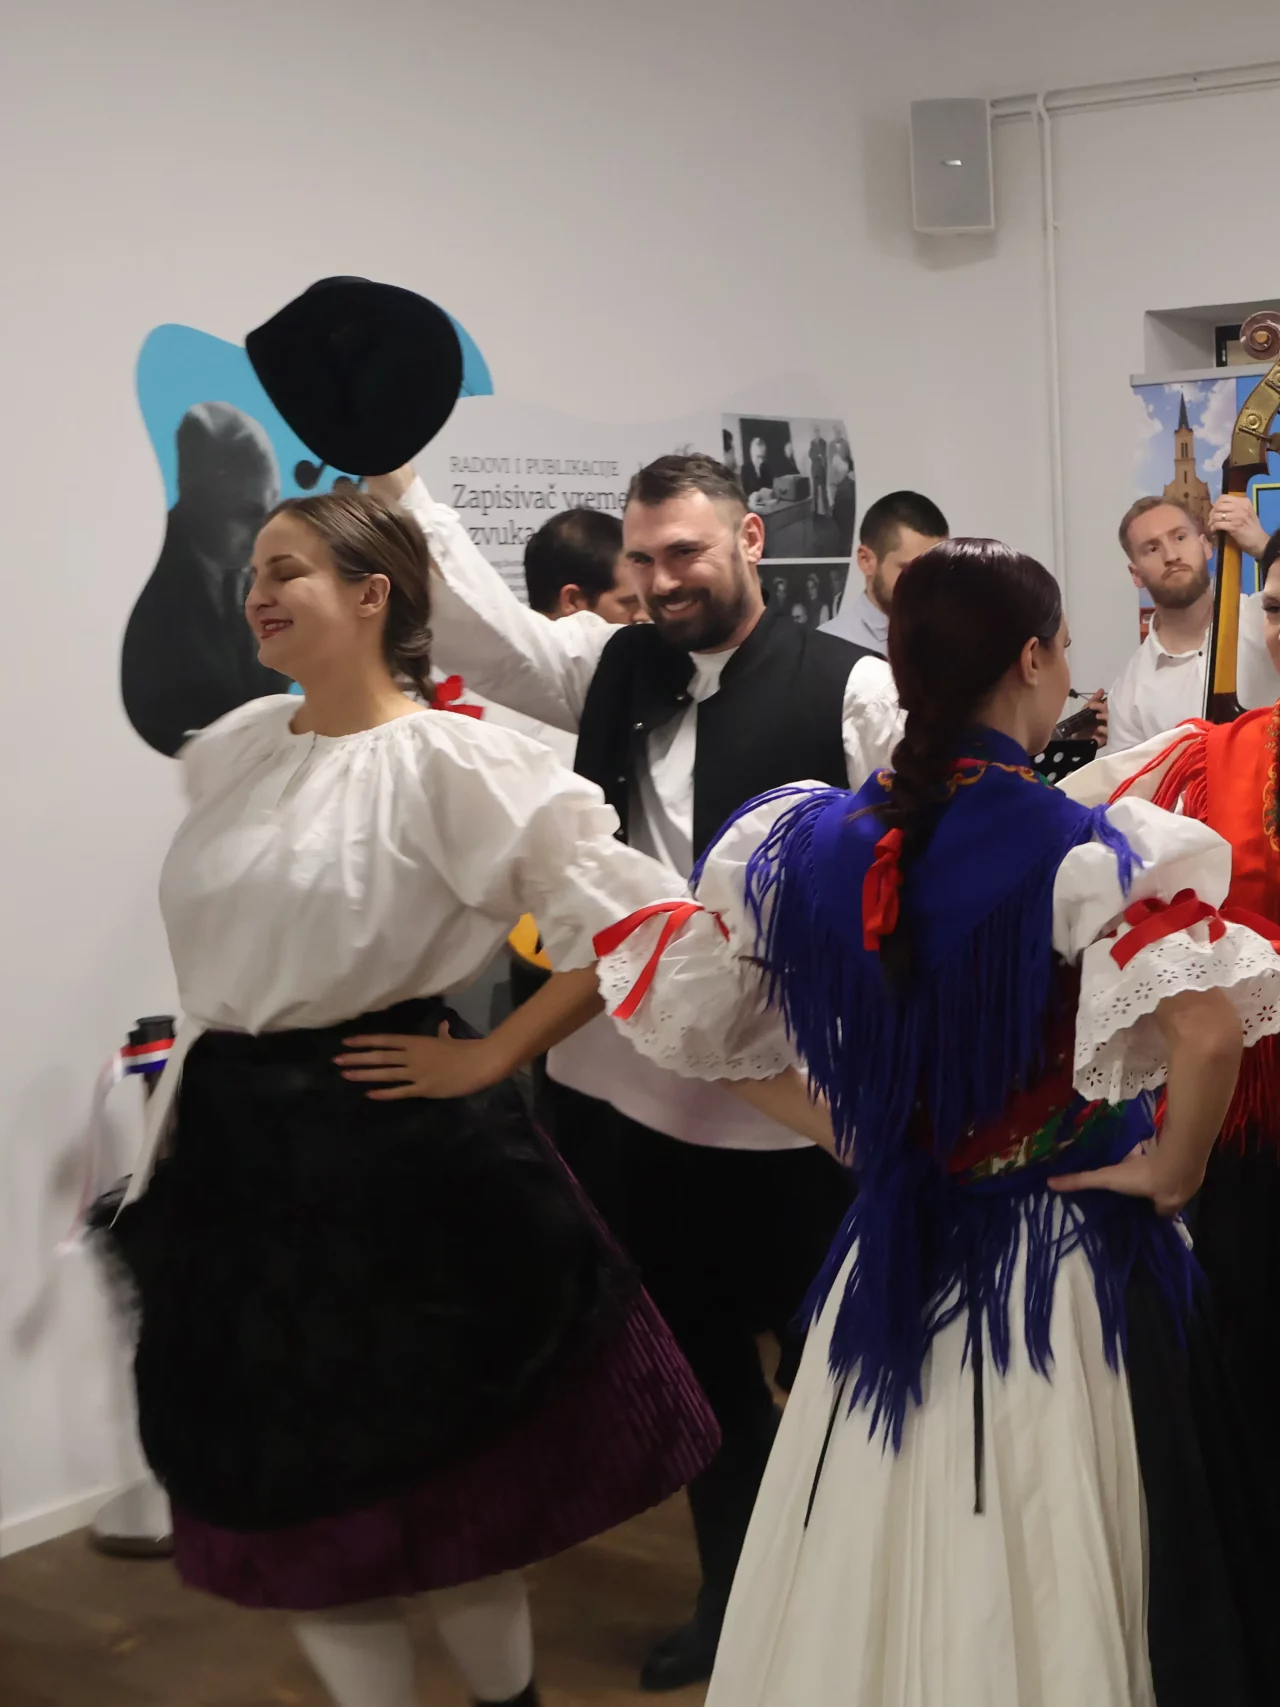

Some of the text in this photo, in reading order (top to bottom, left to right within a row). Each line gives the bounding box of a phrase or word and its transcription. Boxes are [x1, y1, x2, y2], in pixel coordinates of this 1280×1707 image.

[450, 456, 620, 478] RADOVI I PUBLIKACIJE
[453, 483, 558, 515] Zapisivač
